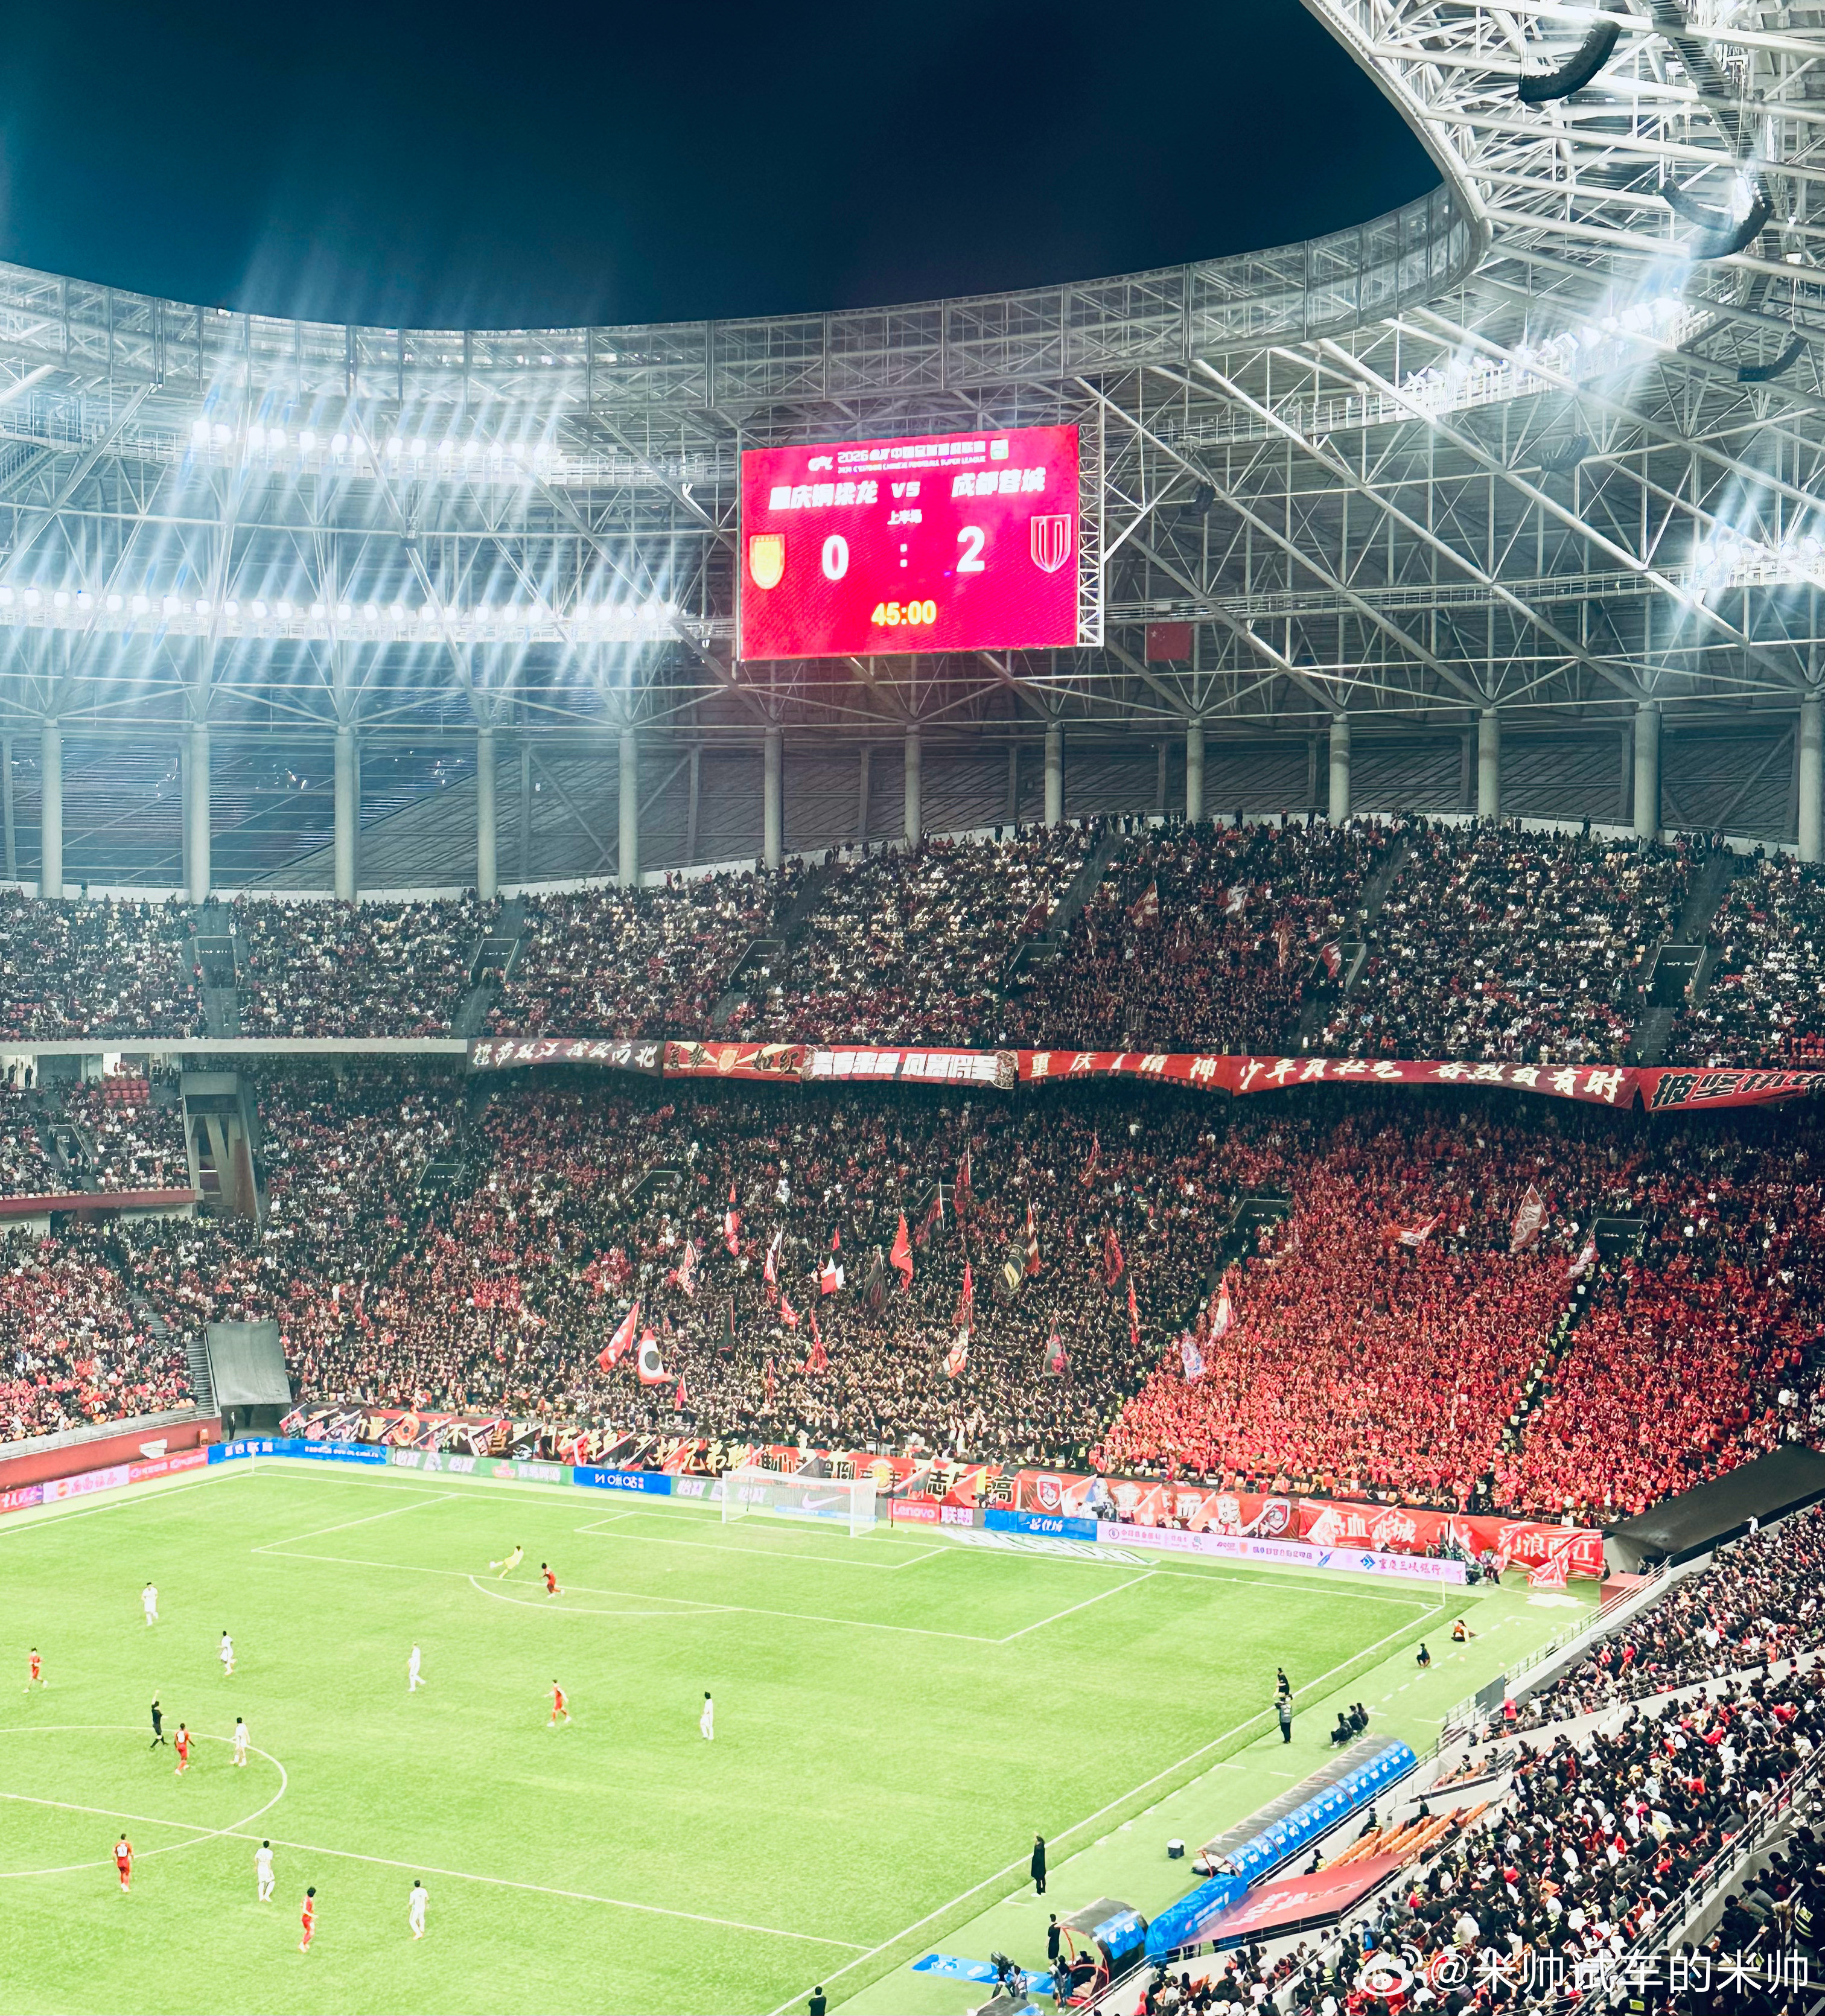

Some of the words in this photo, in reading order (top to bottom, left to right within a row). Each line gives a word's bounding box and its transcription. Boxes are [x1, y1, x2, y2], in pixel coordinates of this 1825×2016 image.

[887, 509, 922, 525] 上半场
[822, 535, 849, 580] 0
[956, 526, 986, 572] 2
[871, 600, 937, 626] 45:00
[893, 1503, 935, 1518] Lenovo
[941, 1505, 973, 1525] 联想
